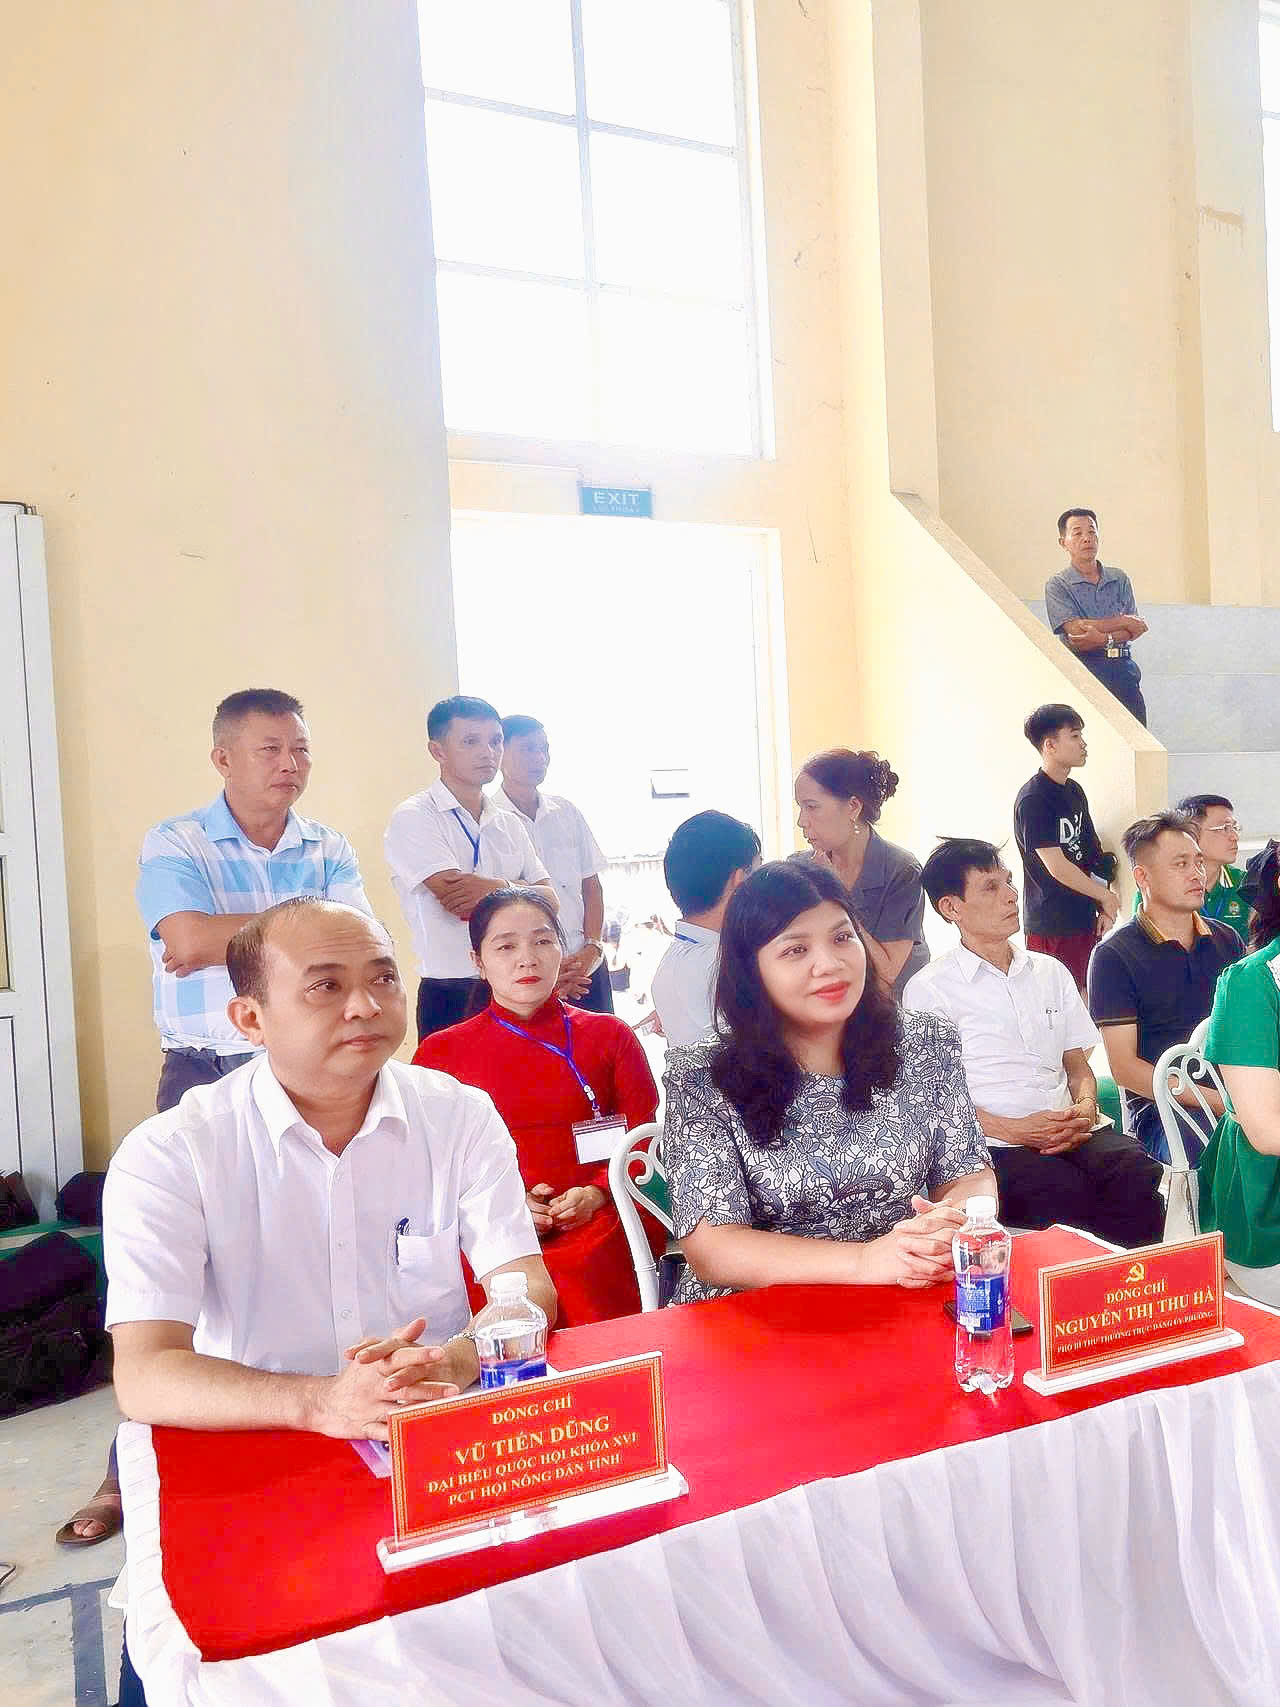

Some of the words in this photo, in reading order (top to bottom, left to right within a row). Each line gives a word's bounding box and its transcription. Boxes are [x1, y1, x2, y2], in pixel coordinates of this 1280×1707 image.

[594, 491, 640, 505] EXIT
[1125, 1302, 1153, 1320] THỊ
[1157, 1293, 1190, 1313] THU
[1193, 1285, 1215, 1305] HÀ
[1143, 1277, 1165, 1296] CHÍ
[543, 1392, 571, 1413] CHÍ
[455, 1441, 486, 1465] VŨ
[550, 1415, 609, 1443] DŨNG
[427, 1476, 455, 1493] ĐẠI
[612, 1431, 638, 1448] XVI
[448, 1488, 476, 1505] PCT
[511, 1470, 552, 1490] NÔNG
